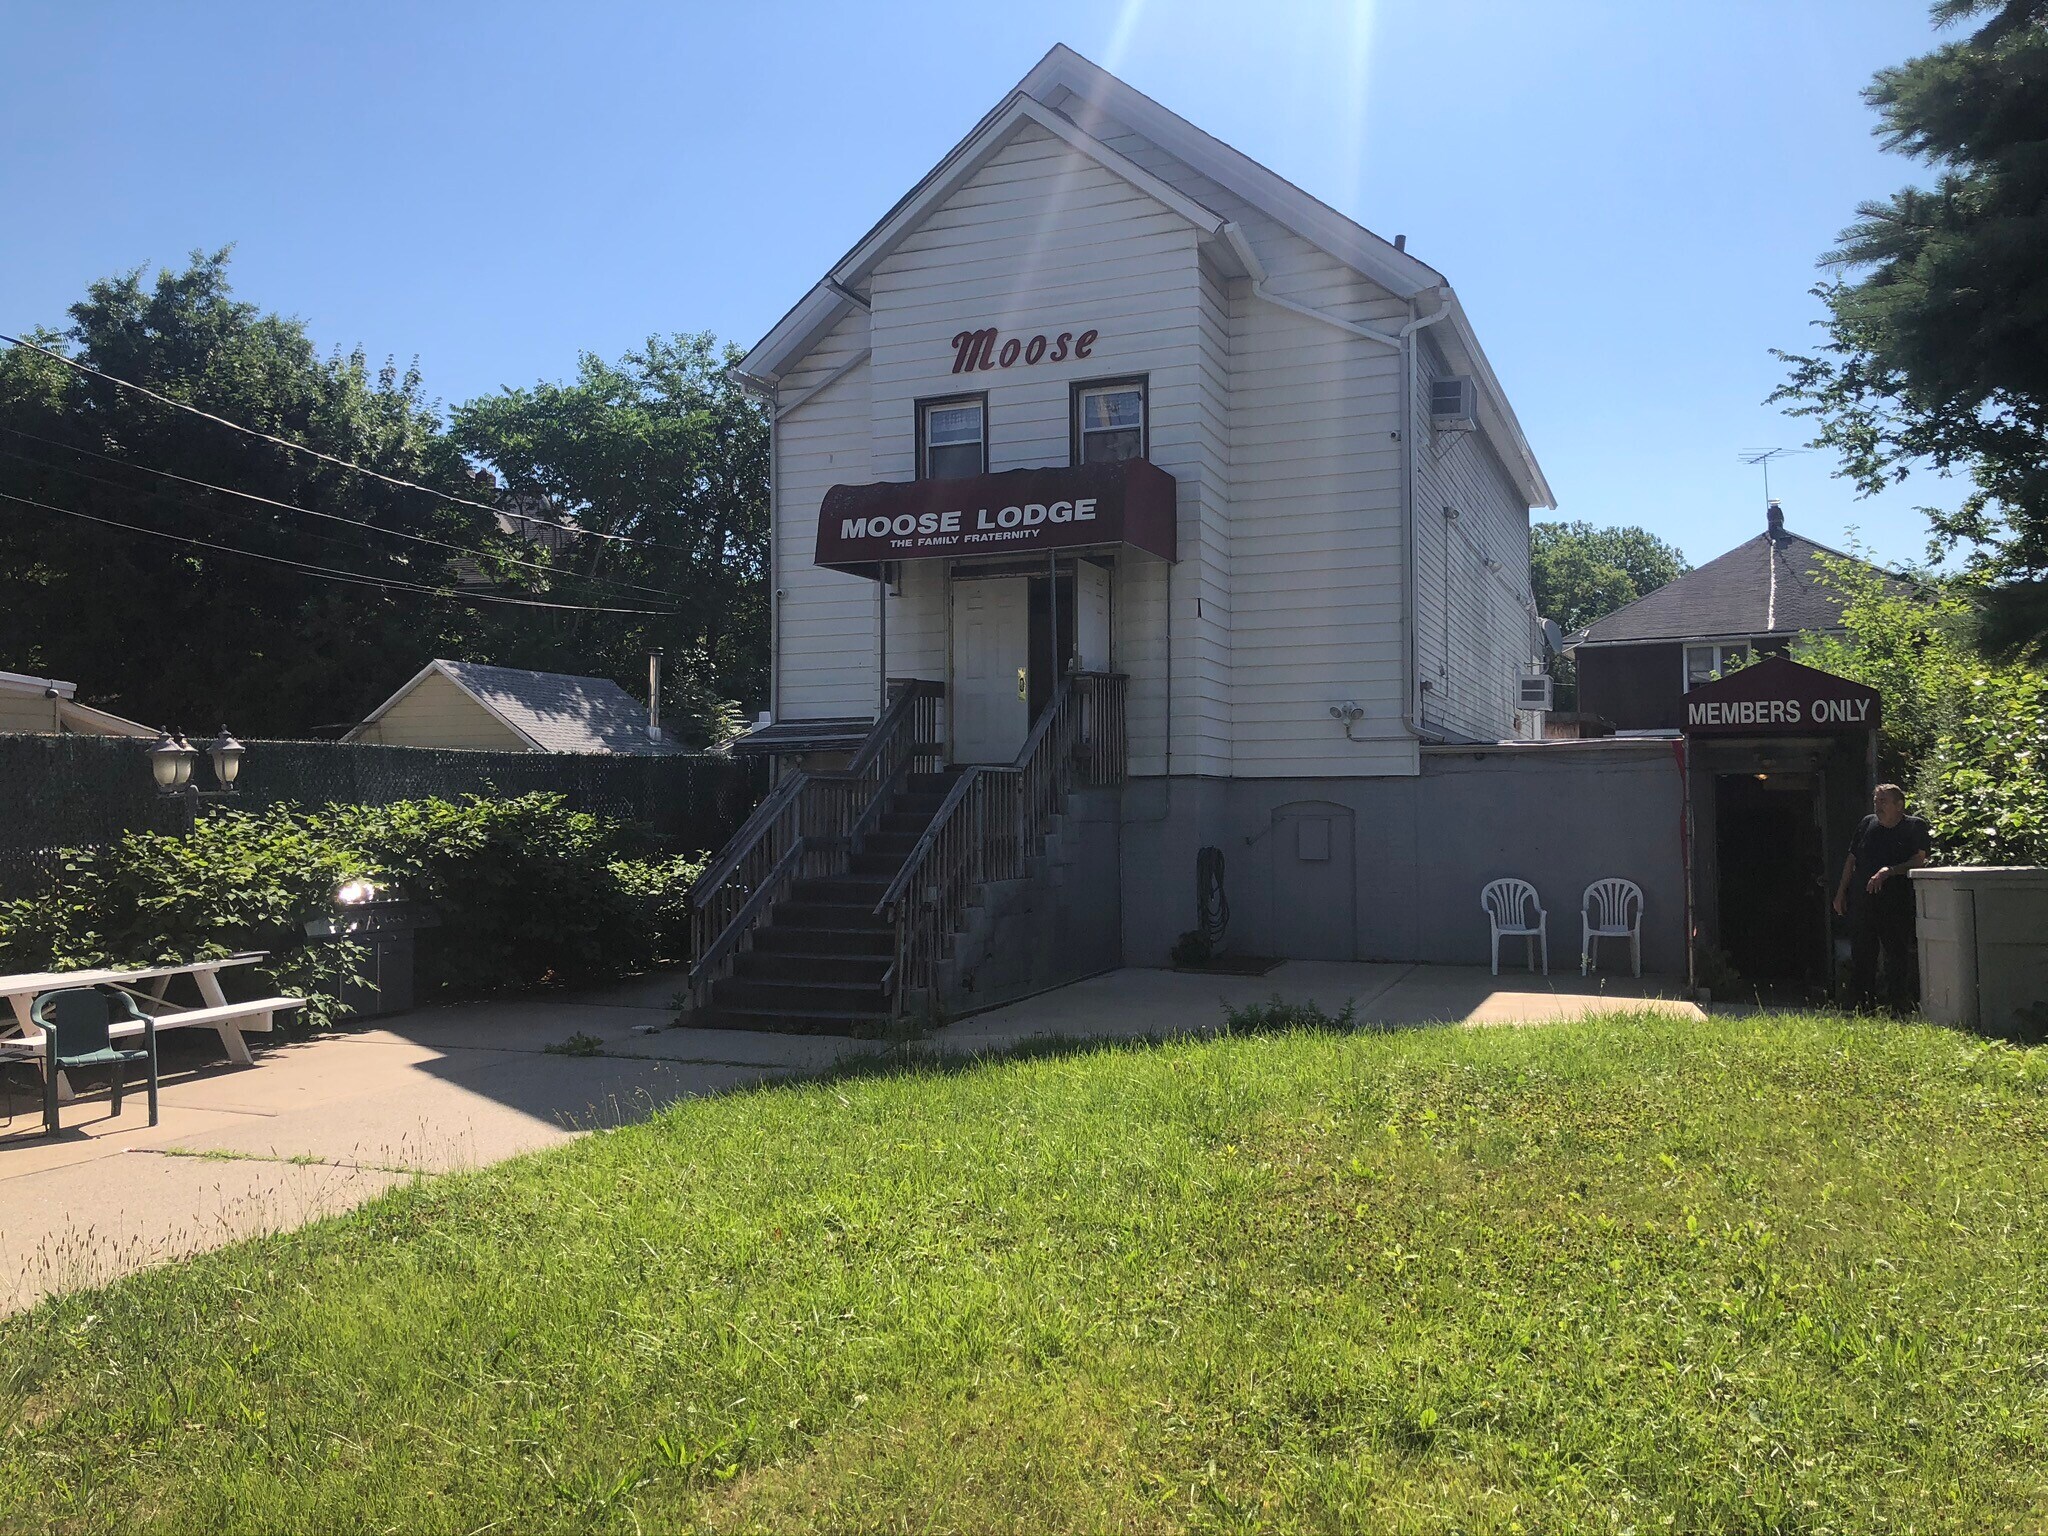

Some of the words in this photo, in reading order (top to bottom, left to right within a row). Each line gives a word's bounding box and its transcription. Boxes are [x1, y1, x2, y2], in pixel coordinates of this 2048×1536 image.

[952, 327, 1098, 374] Moose
[841, 511, 962, 539] MOOSE
[976, 498, 1097, 530] LODGE
[890, 539, 913, 548] THE
[917, 535, 960, 547] FAMILY
[964, 529, 1040, 543] FRATERNITY
[1688, 699, 1800, 725] MEMBERS
[1811, 698, 1870, 724] ONLY
